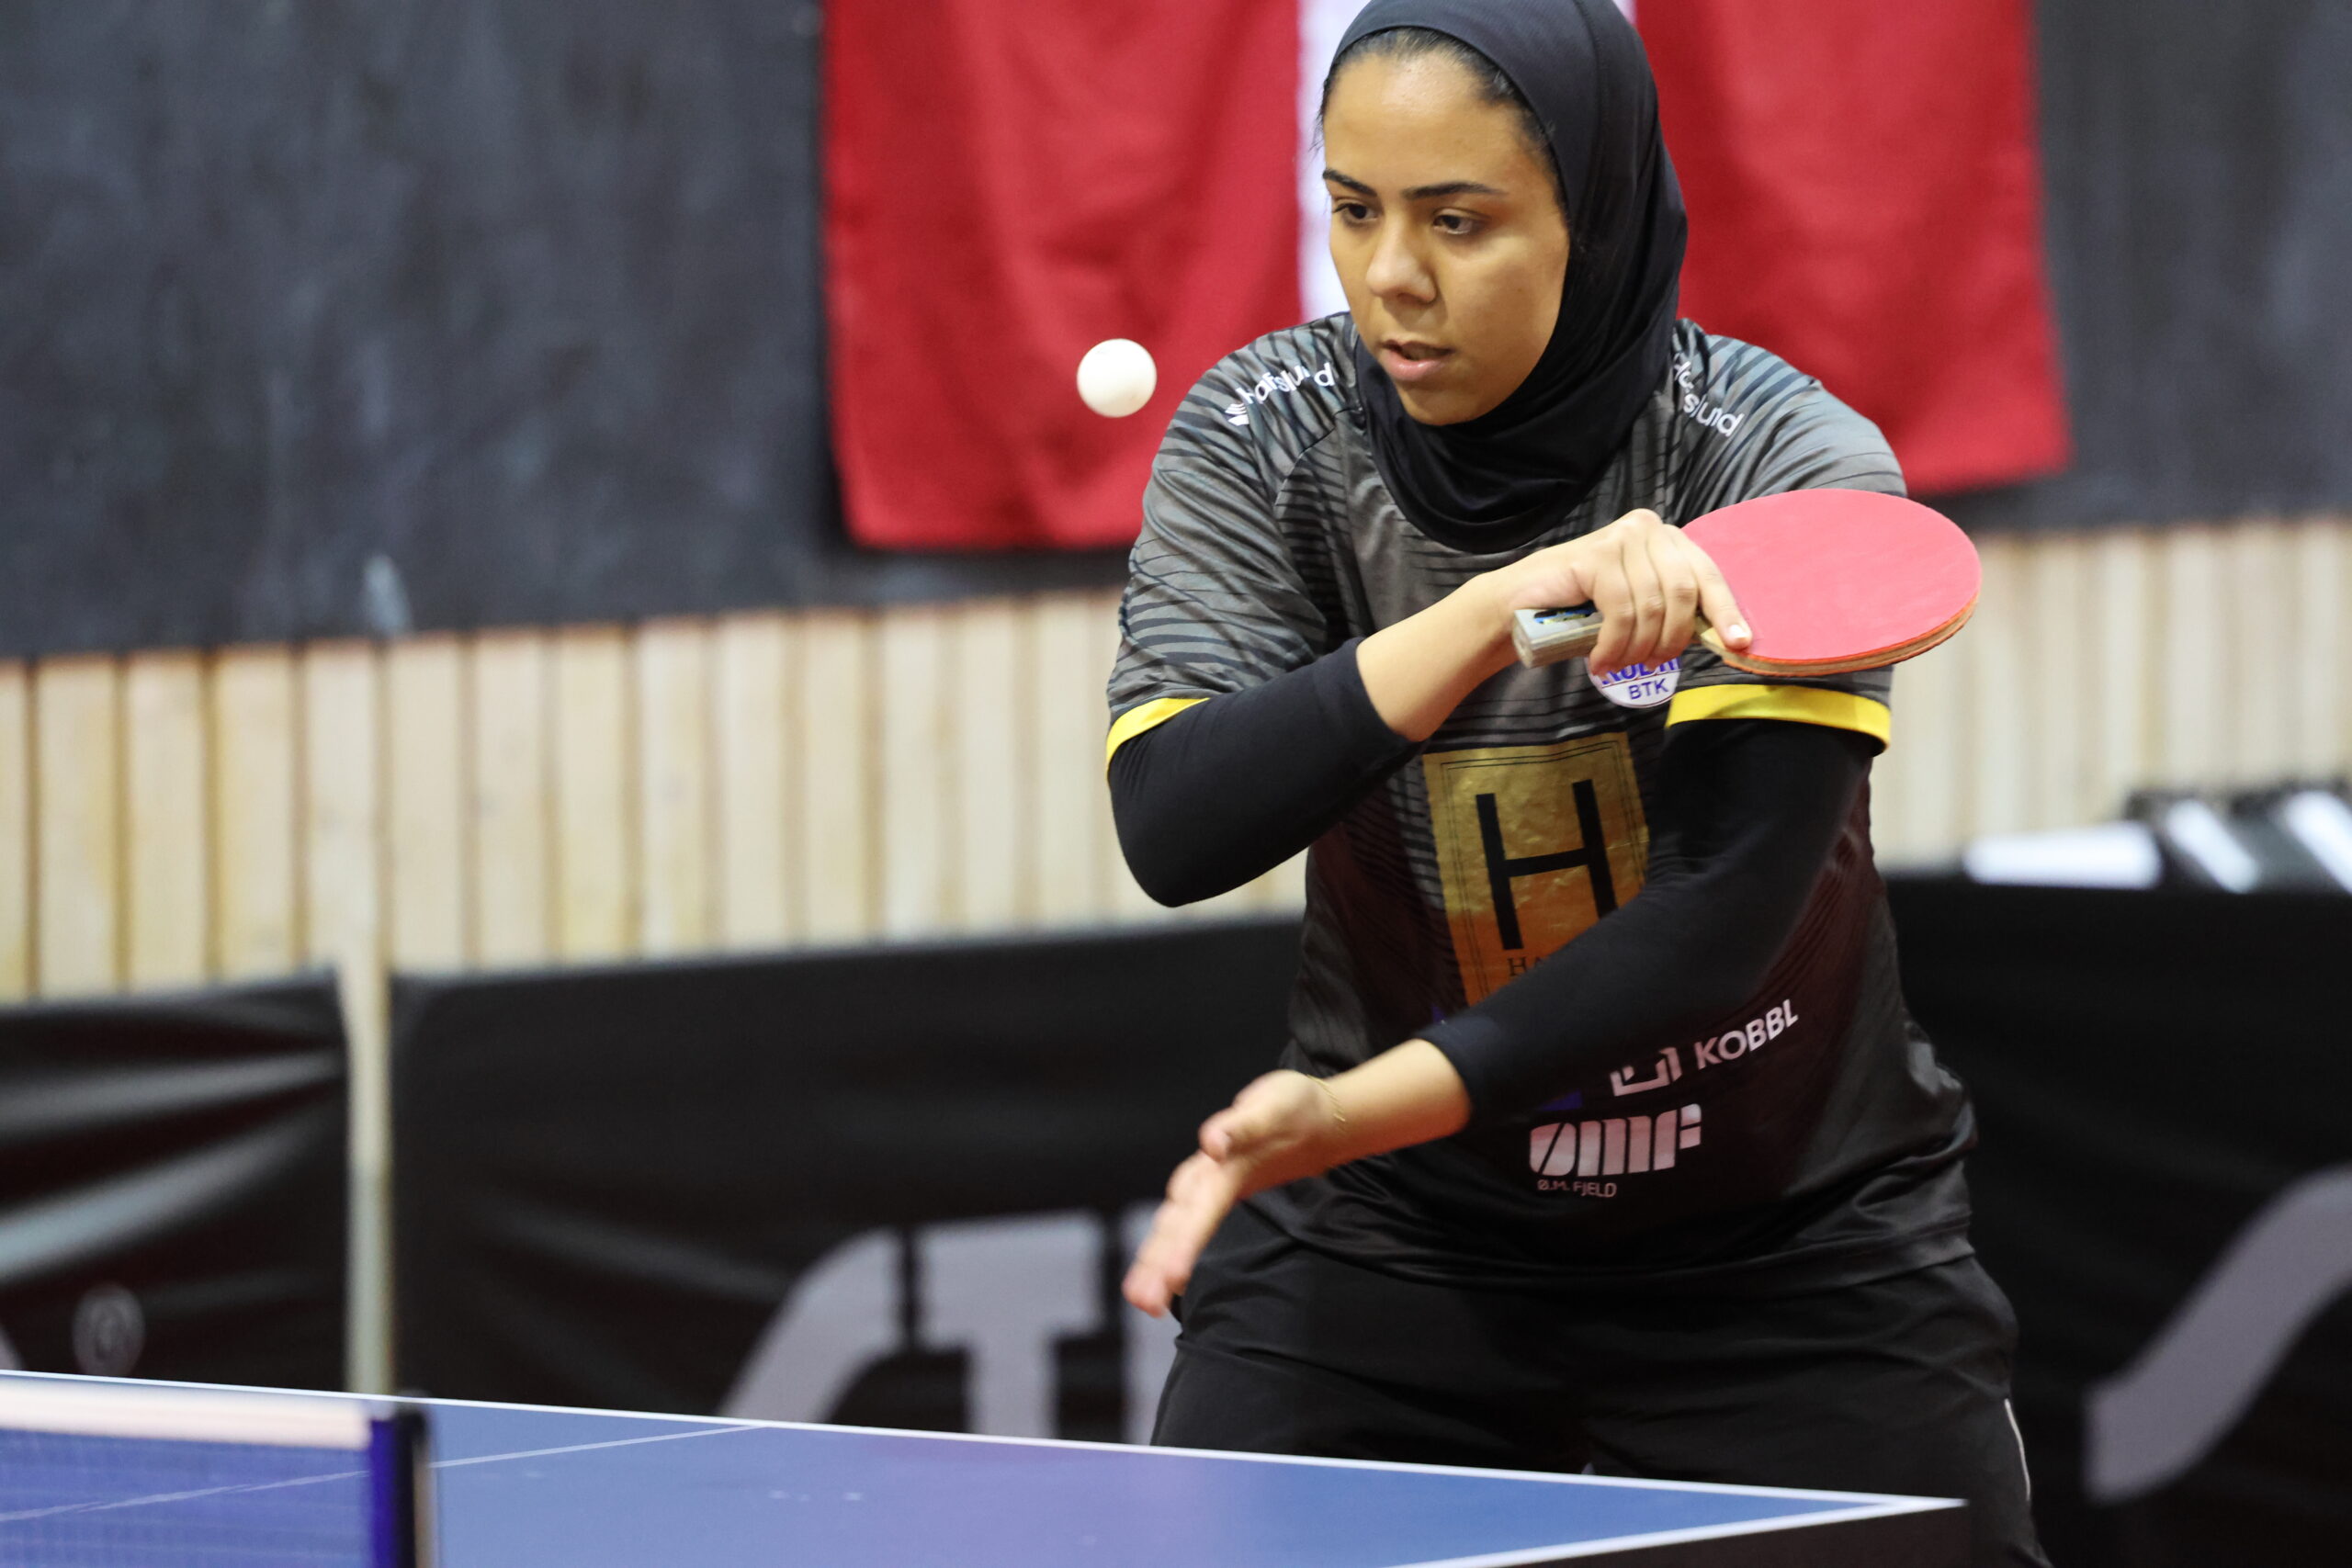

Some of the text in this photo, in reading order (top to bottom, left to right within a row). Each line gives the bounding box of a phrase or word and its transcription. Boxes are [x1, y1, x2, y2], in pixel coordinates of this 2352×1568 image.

[1628, 678, 1668, 699] BTK
[1475, 778, 1619, 950] H
[1693, 998, 1799, 1070] KOBBL
[1573, 1180, 1617, 1198] FJELD
